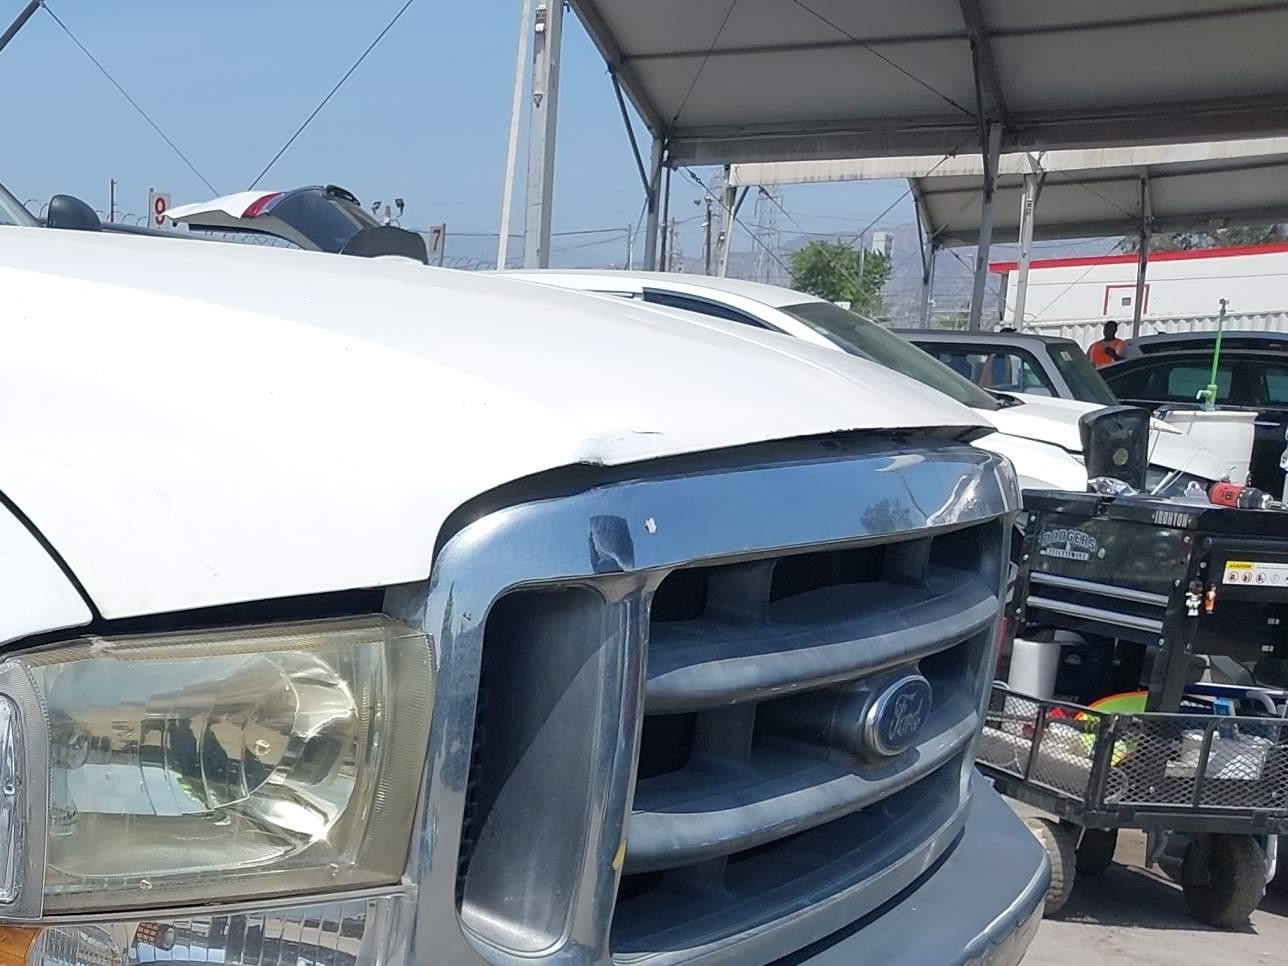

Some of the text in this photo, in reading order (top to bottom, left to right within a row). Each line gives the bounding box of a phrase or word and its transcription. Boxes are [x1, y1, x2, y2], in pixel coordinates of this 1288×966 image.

[433, 229, 441, 251] 7
[1154, 510, 1189, 528] IRONTON
[1040, 528, 1097, 552] DODGERS
[888, 692, 924, 741] Ford
